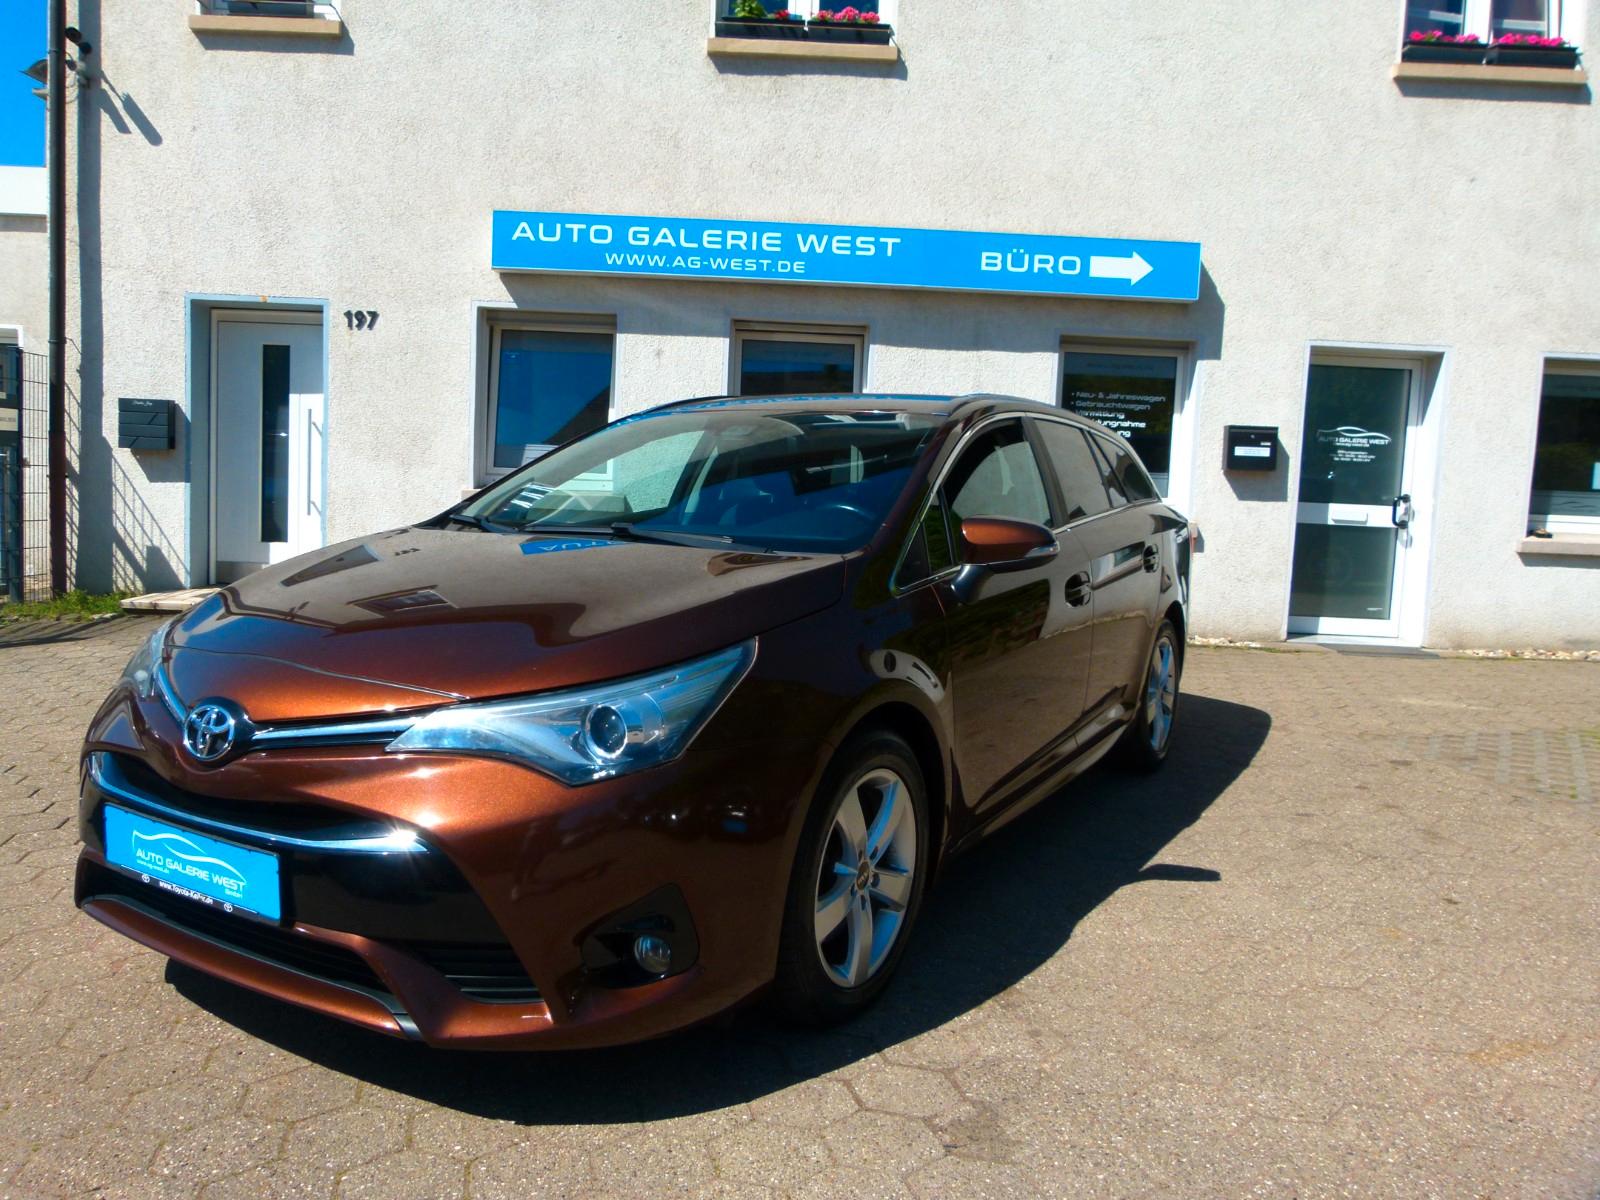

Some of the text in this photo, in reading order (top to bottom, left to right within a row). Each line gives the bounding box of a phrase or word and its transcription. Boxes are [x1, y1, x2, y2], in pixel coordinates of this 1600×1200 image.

[511, 221, 902, 257] AUTO GALERIE WEST
[605, 252, 806, 274] WWW.AG-WEST.DE
[980, 248, 1082, 276] BÜRO
[343, 310, 380, 331] 197
[1075, 400, 1151, 411] Gebrauchtwagen
[1106, 392, 1166, 403] Jahreswagen
[136, 847, 246, 892] AUTO GALERIE WEST
